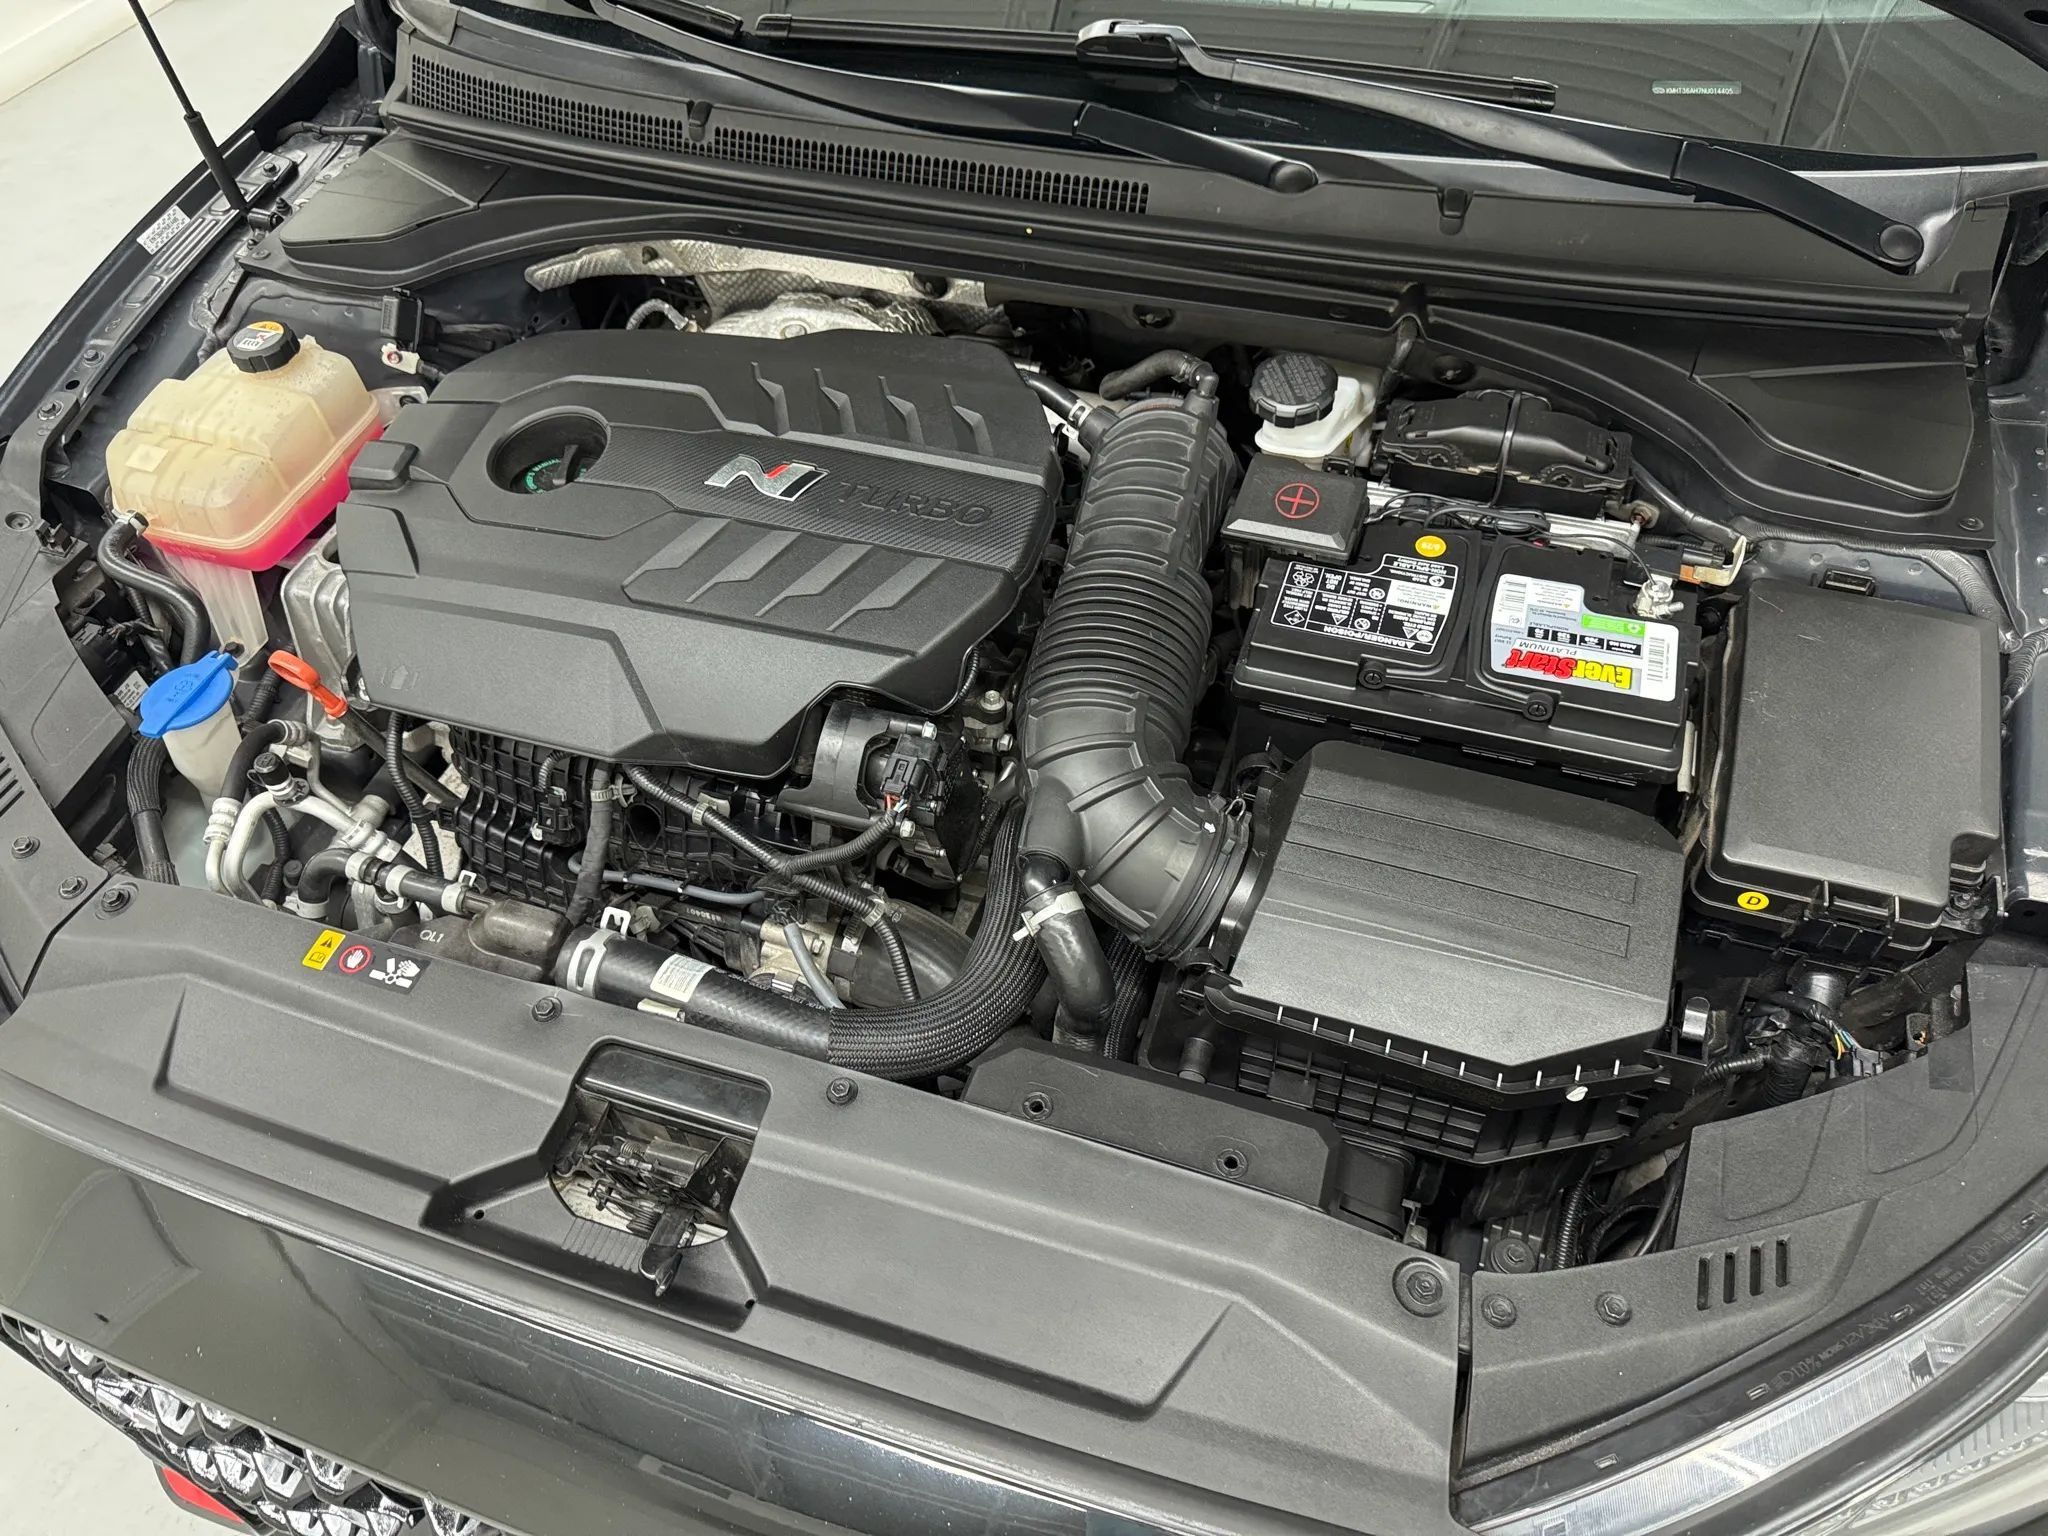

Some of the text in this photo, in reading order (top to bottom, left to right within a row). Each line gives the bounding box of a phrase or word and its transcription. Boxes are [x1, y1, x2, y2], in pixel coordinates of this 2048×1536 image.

[838, 481, 993, 527] TURBO
[1393, 561, 1446, 574] NON-SPILLABLE
[1324, 572, 1341, 580] OPEN.
[1323, 625, 1406, 647] DANGER/POISON
[1518, 640, 1577, 655] PLATINUM
[1504, 649, 1632, 690] EverStart
[1746, 895, 1761, 905] D
